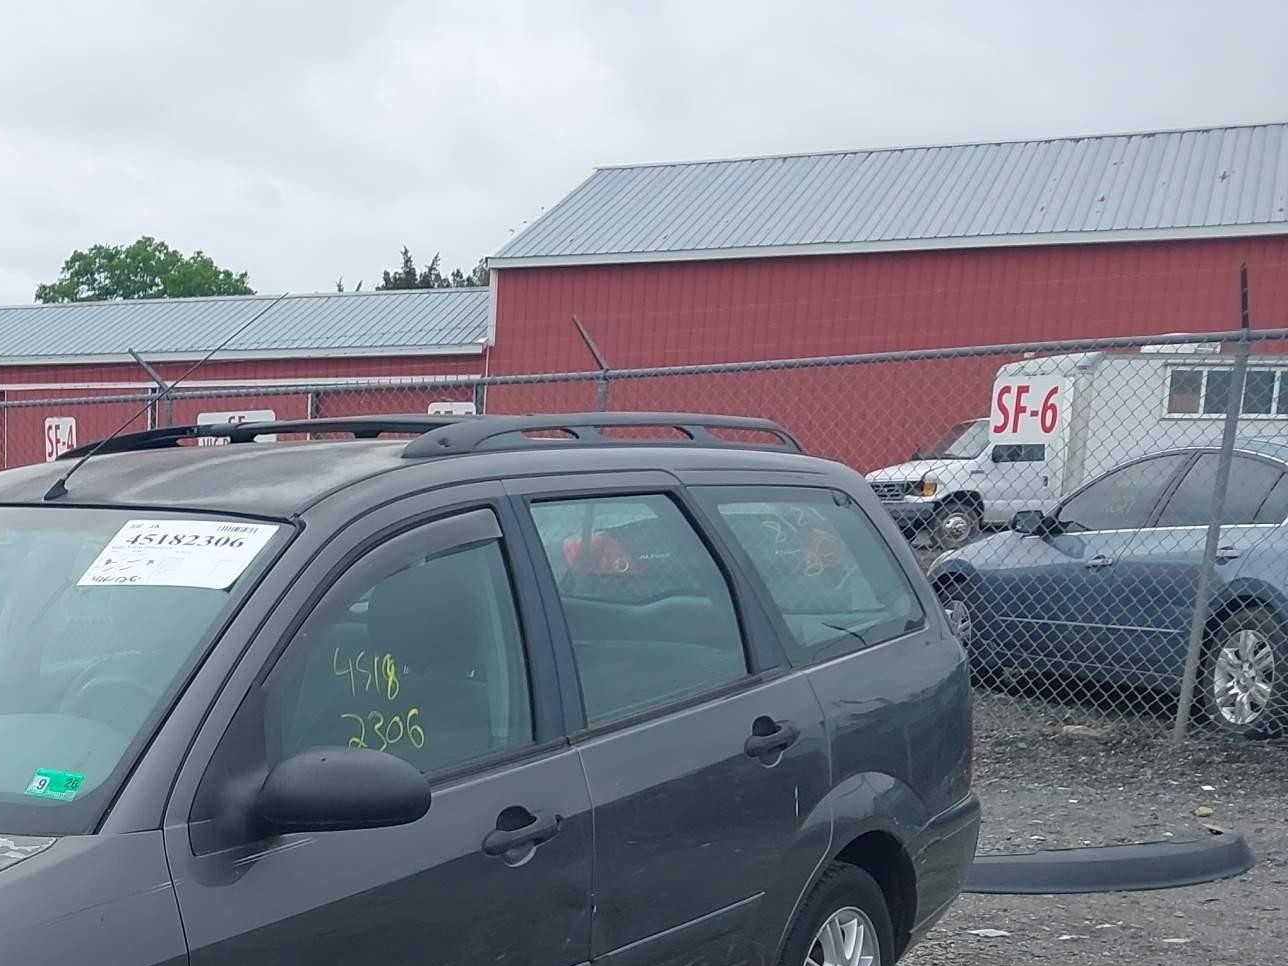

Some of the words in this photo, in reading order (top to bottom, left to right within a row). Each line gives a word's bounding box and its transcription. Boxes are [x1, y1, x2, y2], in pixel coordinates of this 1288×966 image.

[993, 385, 1058, 433] SF-6
[47, 424, 74, 458] SF-4
[125, 533, 247, 548] 45182306
[333, 648, 399, 700] 4518
[341, 708, 425, 752] 2306
[36, 778, 47, 790] 9
